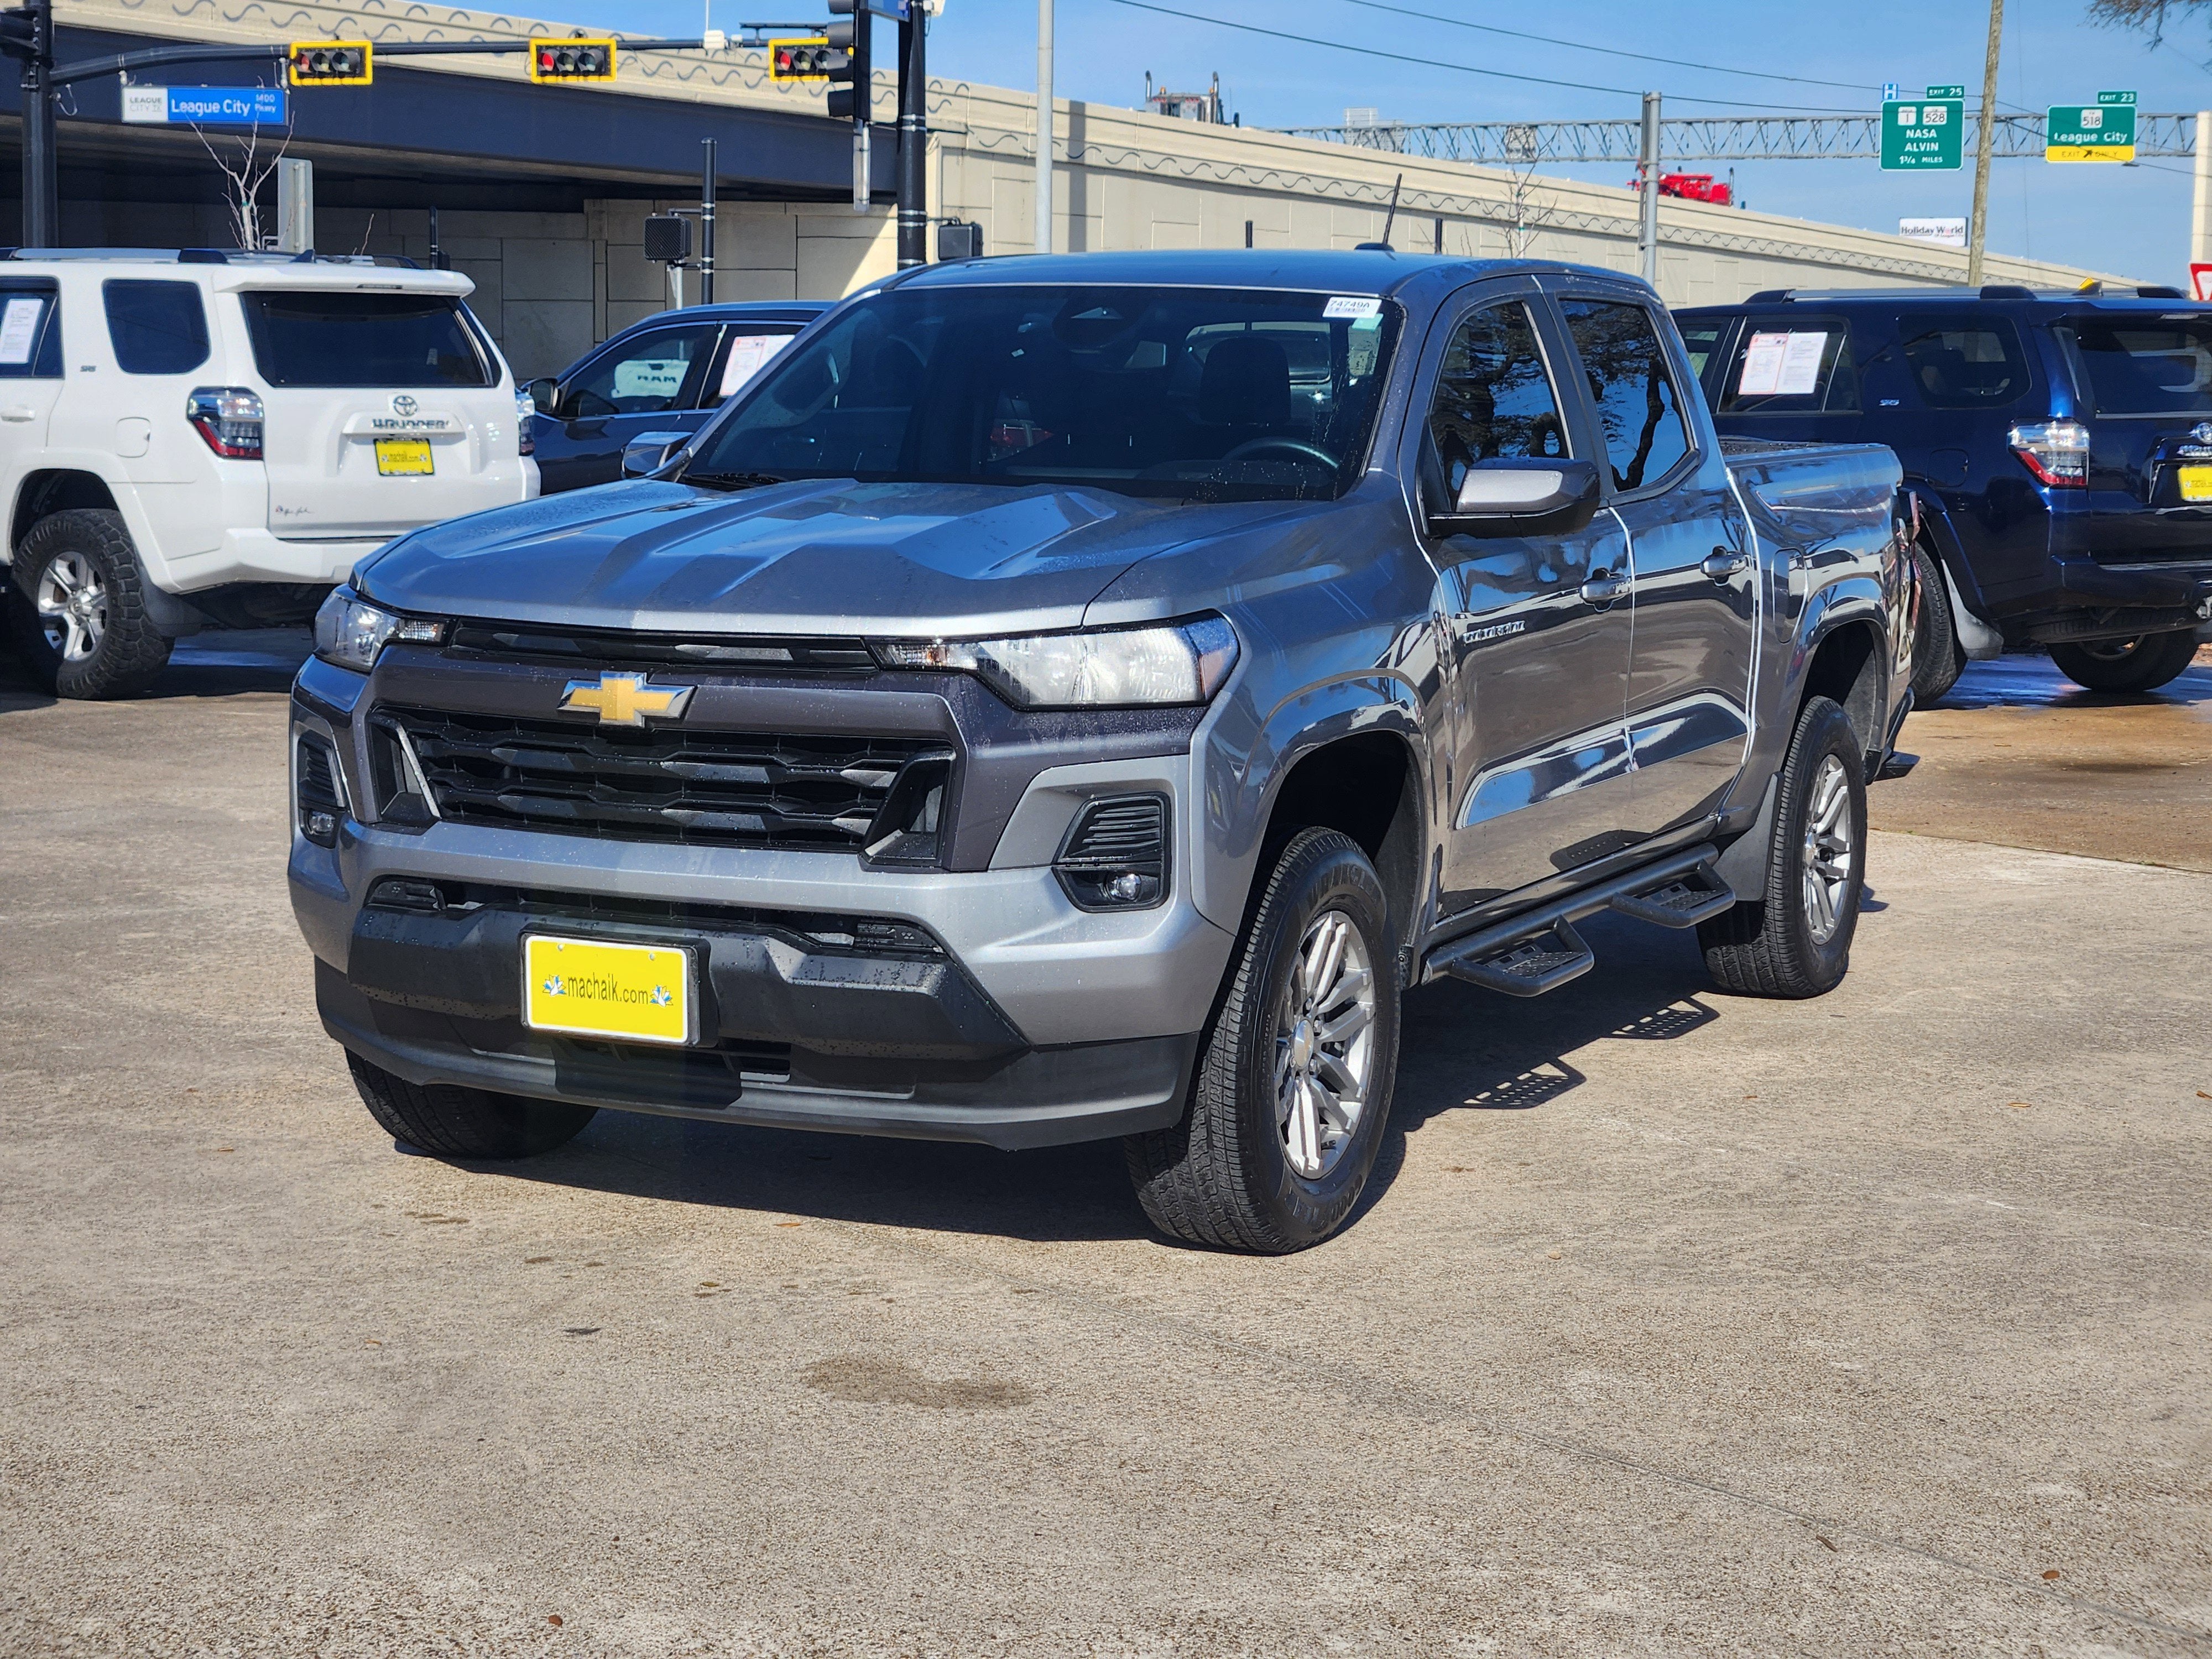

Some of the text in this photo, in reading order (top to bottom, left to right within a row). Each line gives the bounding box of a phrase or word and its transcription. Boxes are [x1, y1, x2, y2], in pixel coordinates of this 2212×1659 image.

[1949, 88, 1963, 96] 25
[2121, 93, 2135, 103] 23
[171, 98, 251, 117] League City
[1925, 113, 1945, 123] 528
[2083, 116, 2101, 126] 518
[1906, 128, 1938, 138] NASA
[2054, 132, 2127, 144] League City
[1904, 142, 1939, 152] ALVIN
[1901, 226, 1964, 234] Holiday World
[568, 972, 648, 1004] machaik.com
